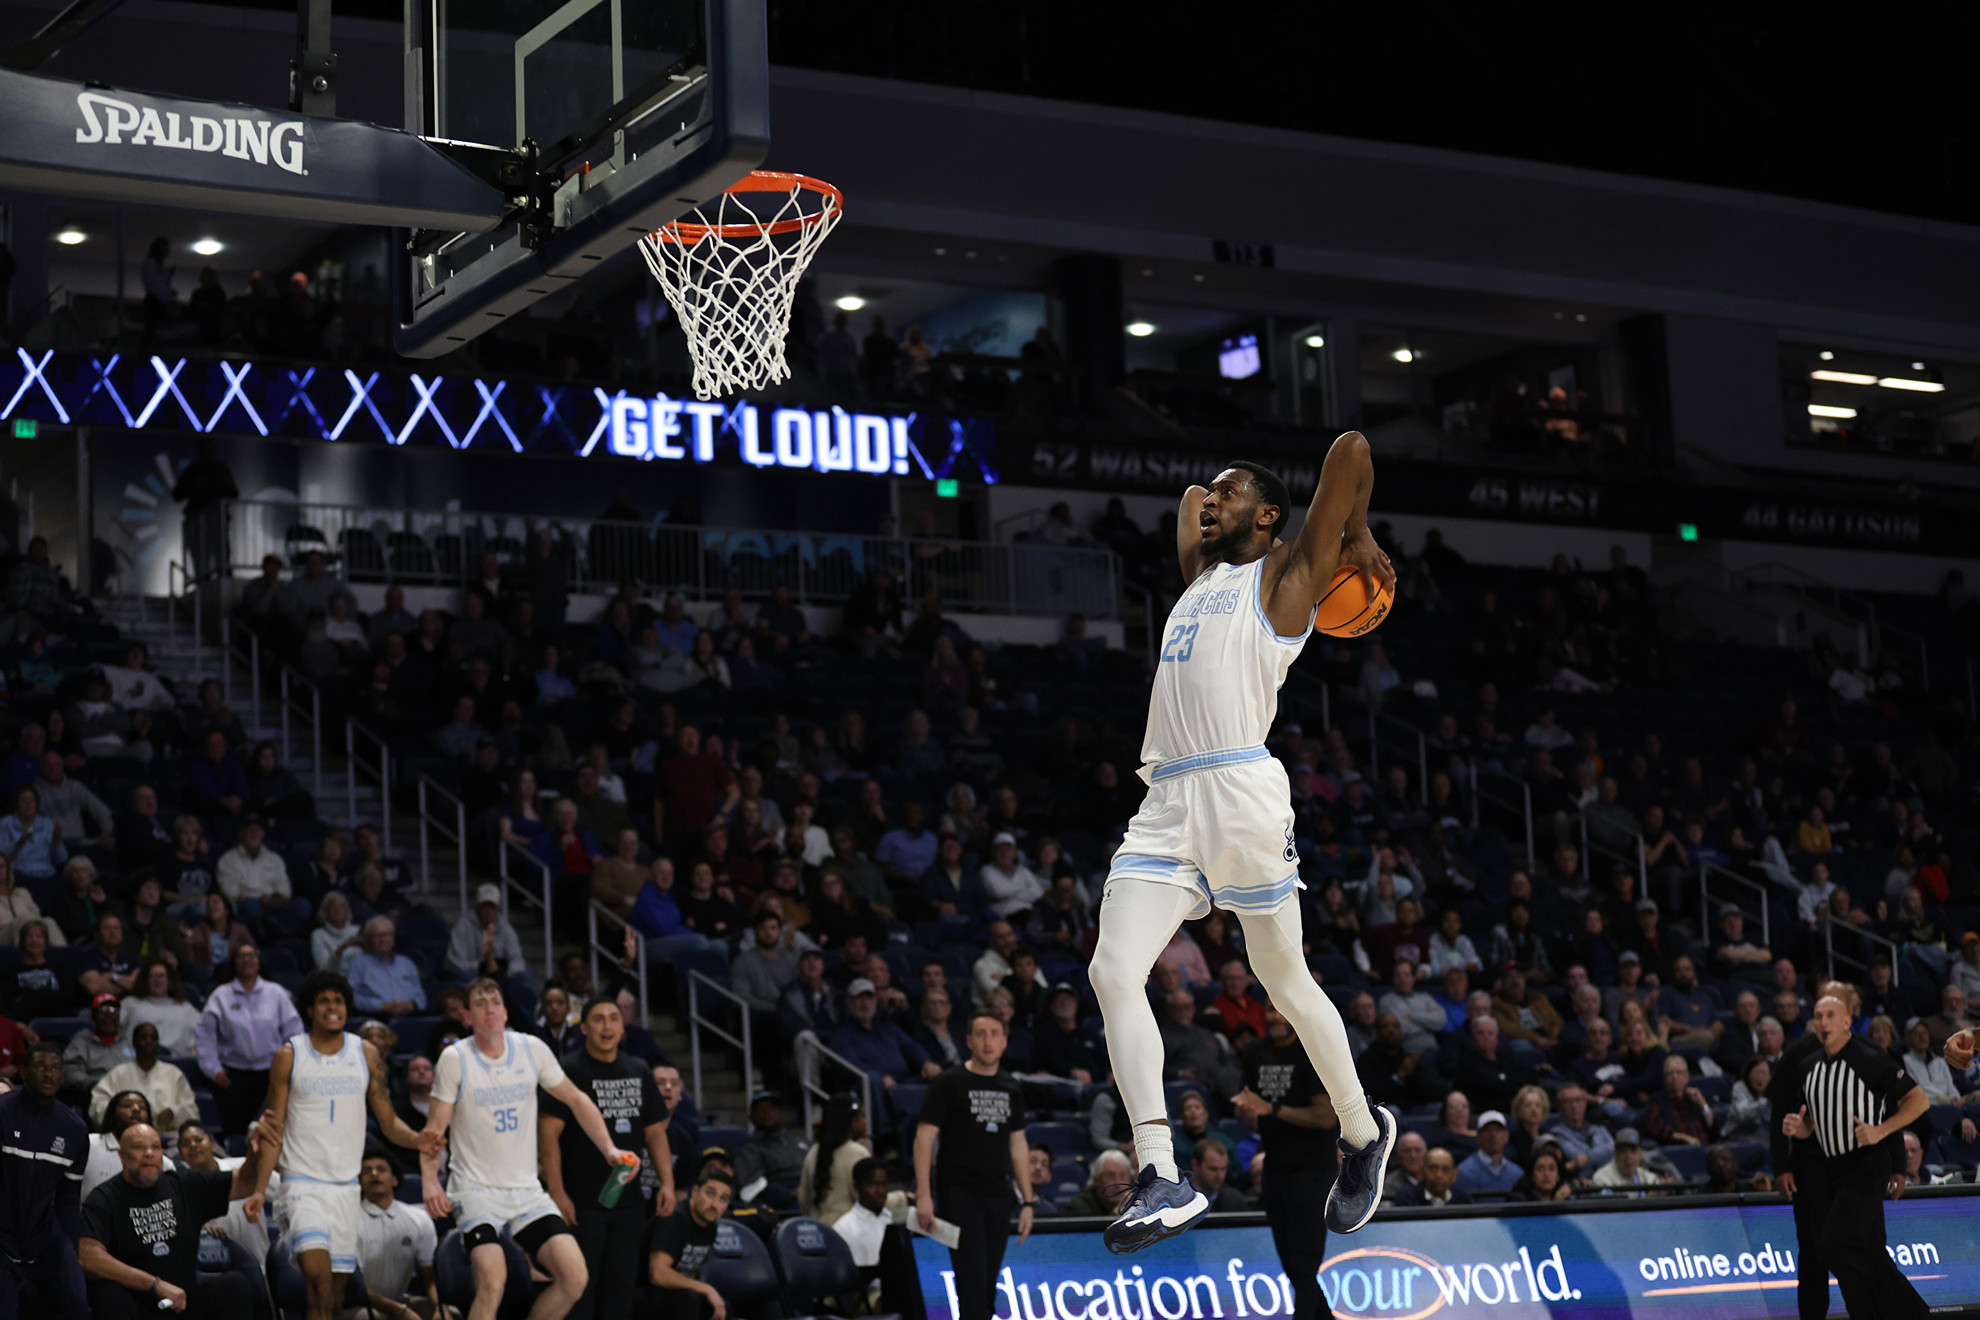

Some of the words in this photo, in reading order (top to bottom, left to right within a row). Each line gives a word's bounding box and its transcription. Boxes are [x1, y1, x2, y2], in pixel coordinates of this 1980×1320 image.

[76, 92, 305, 175] SPALDING
[608, 396, 726, 462] GET
[741, 405, 909, 475] LOUD!
[1033, 445, 1079, 477] 52
[1469, 478, 1509, 509] 45
[1518, 480, 1602, 518] WEST
[1743, 502, 1779, 528] 44
[1348, 602, 1387, 636] NCAA
[1161, 622, 1200, 662] 23
[329, 1099, 335, 1123] 1
[494, 1108, 518, 1133] 35
[1429, 1244, 1583, 1307] world.
